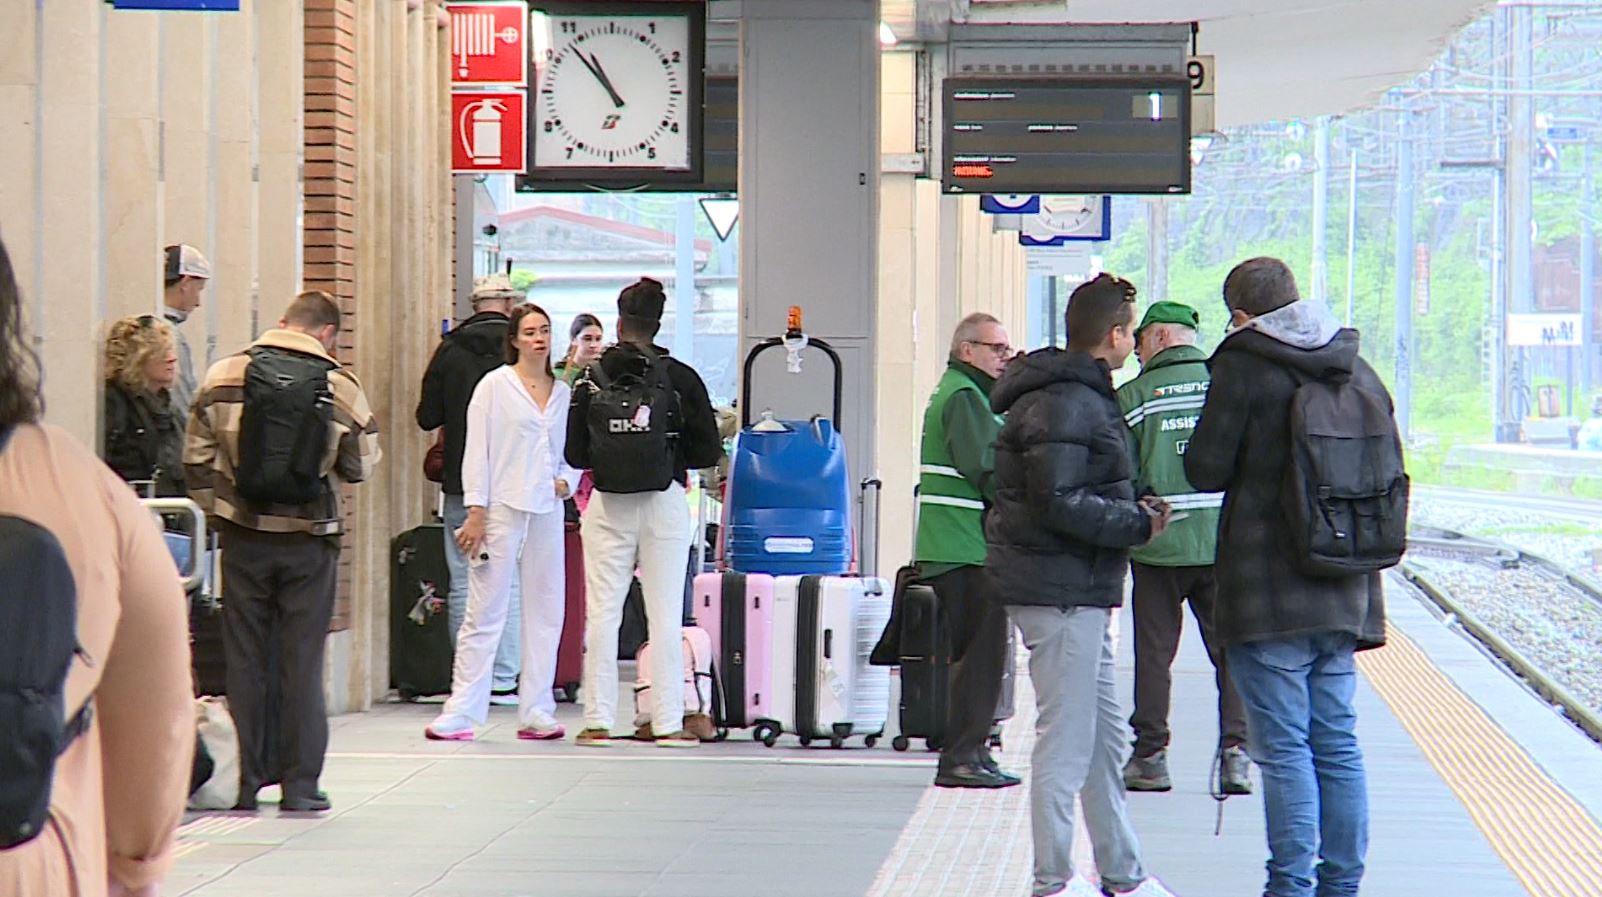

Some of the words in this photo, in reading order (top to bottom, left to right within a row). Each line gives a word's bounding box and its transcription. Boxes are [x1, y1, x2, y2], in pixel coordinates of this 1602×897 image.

[561, 21, 576, 33] 11
[648, 22, 656, 34] 1
[671, 51, 681, 63] 2
[1149, 93, 1161, 119] 1
[670, 122, 679, 134] 4
[566, 147, 574, 160] 7
[647, 147, 656, 159] 5
